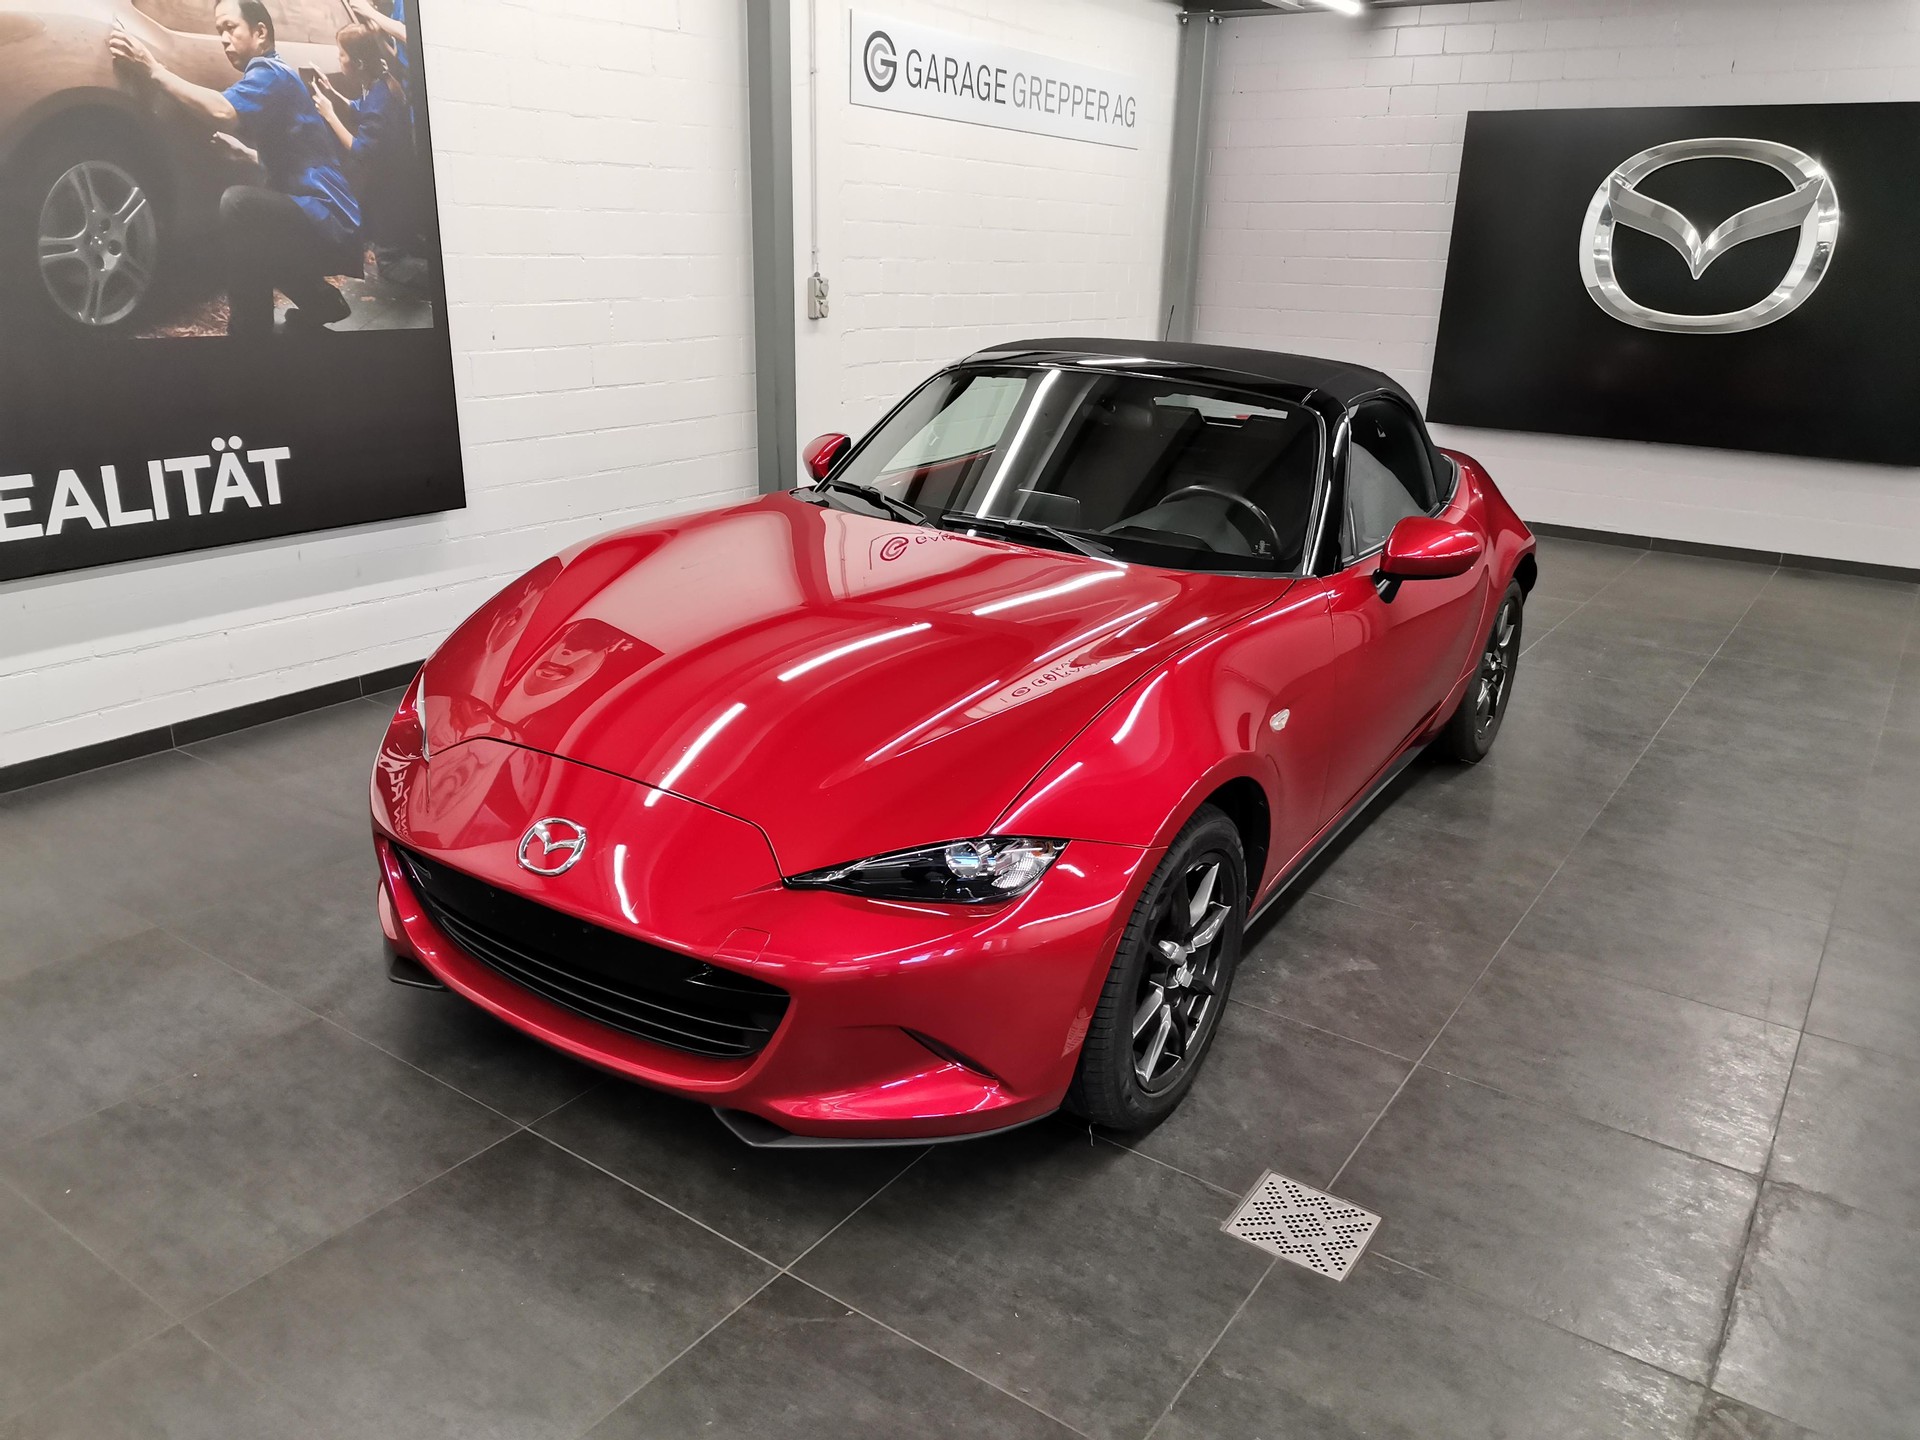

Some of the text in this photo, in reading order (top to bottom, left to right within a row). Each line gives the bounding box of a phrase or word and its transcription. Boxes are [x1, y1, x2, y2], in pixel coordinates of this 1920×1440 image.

[905, 48, 1137, 128] GARAGE GREPPER AG
